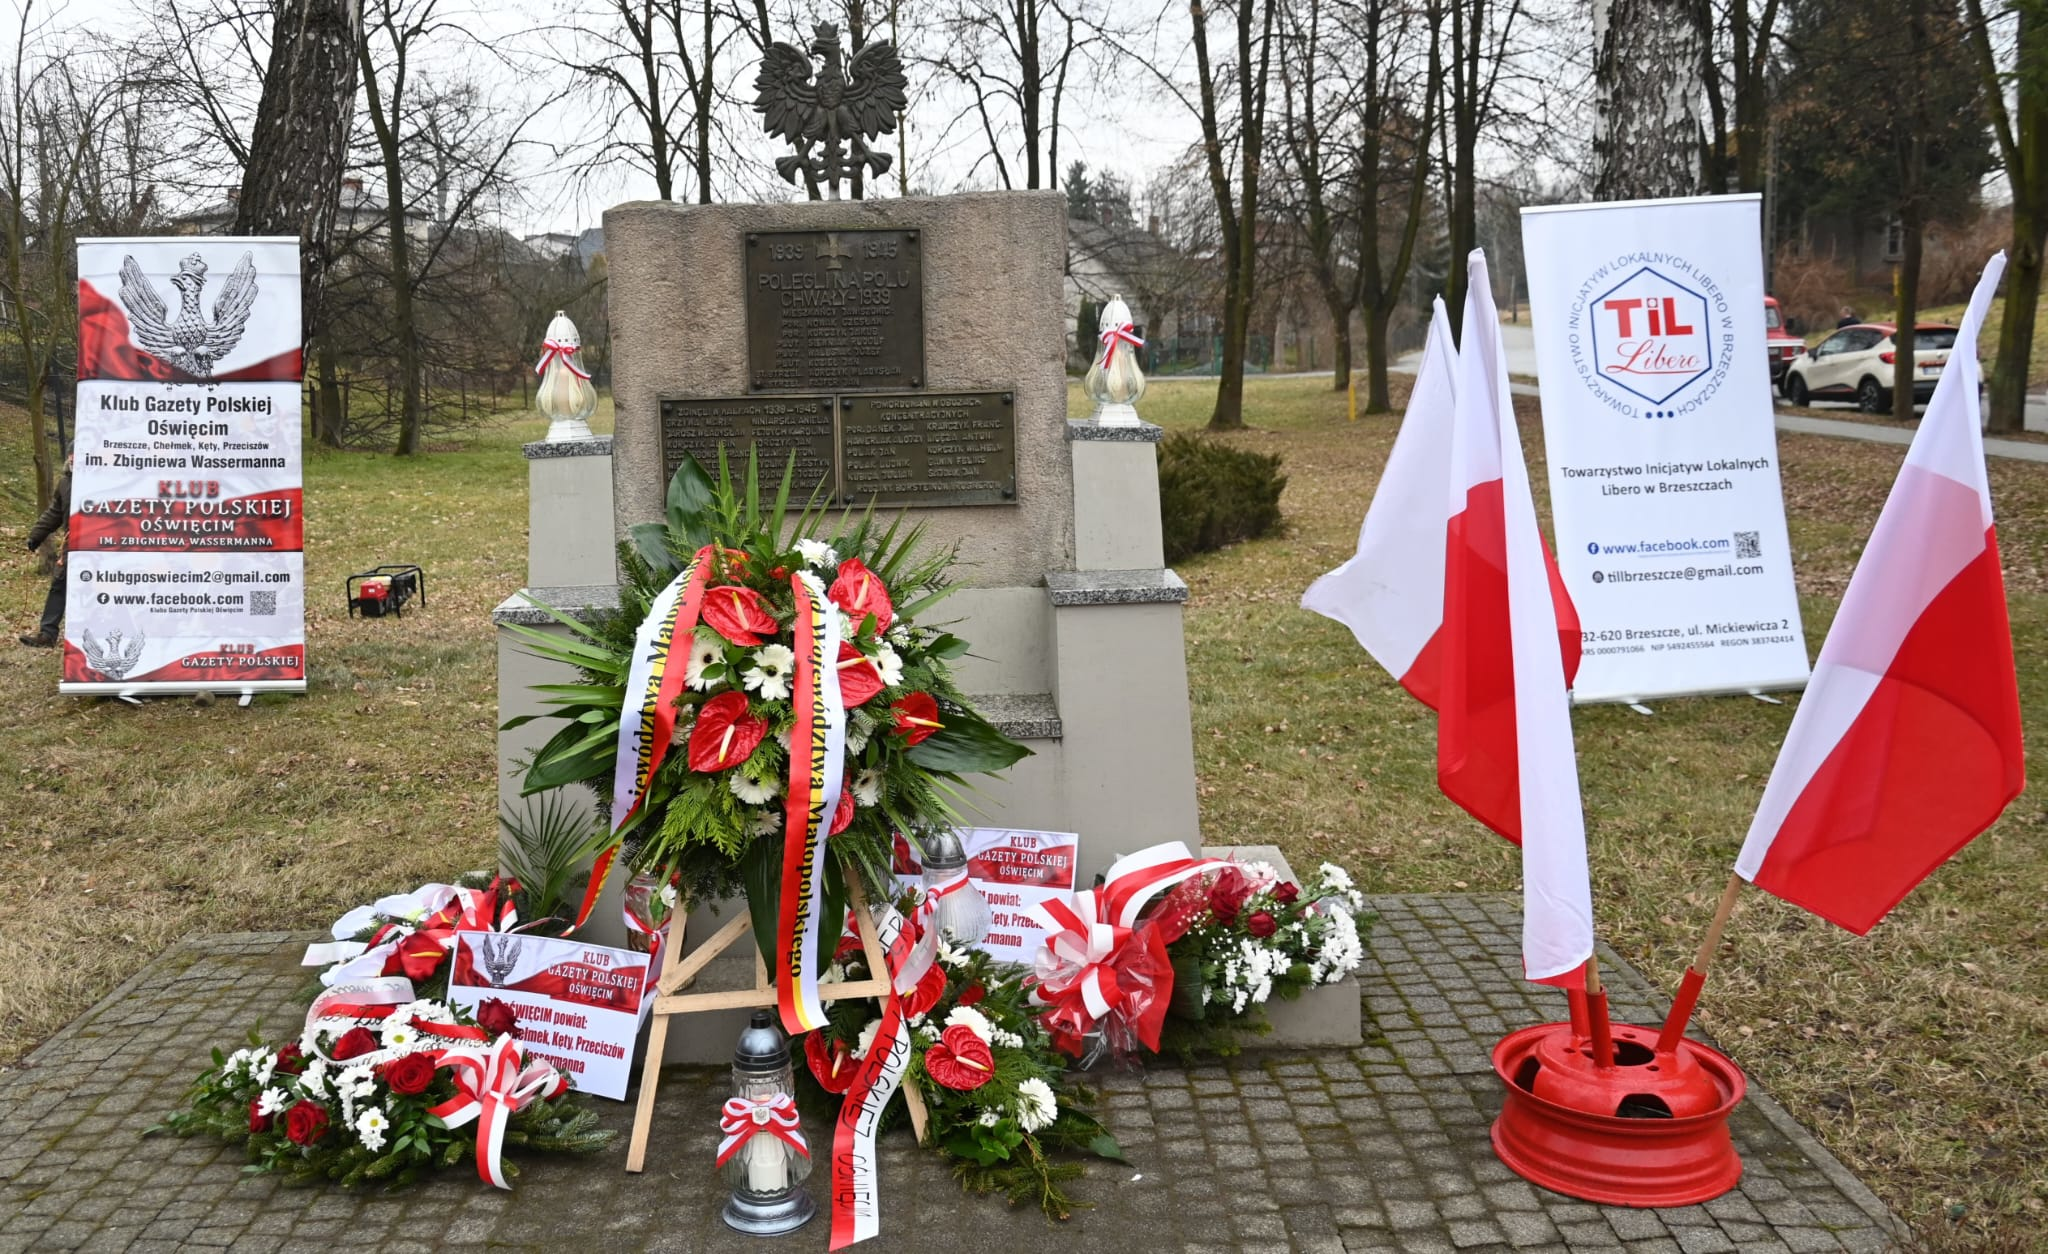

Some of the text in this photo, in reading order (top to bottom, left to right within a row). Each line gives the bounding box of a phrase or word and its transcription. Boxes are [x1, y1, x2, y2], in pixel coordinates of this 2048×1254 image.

[768, 239, 898, 261] 1939 1945
[758, 270, 910, 290] POLEGLI NA POLU
[1568, 251, 1734, 419] TOWARZYSTWO INICJATYW LOKALNYCH LIBERO W BRZESZCZACH
[1606, 339, 1702, 375] Libero
[101, 394, 272, 416] Klub Gazety Polskiej
[764, 404, 786, 415] 1939
[148, 420, 228, 439] Oświęcim
[103, 440, 269, 452] Brzeszcze, Chełmek, Kęty, Przeciszów
[85, 454, 286, 472] im. Zbigniewa Wassermanna
[1561, 457, 1769, 479] Towarzystwo Inicjatyw Lokalnych
[158, 480, 221, 498] KLUB
[1602, 479, 1733, 496] Libero w Brzeszczach
[80, 499, 292, 517] GAZETY POLSKIEJ
[140, 516, 235, 534] OŚWIĘCIM
[99, 537, 273, 546] IM. ZBIGNIEWA WASSERMANNA
[1603, 538, 1730, 555] www.facebook.com
[96, 571, 290, 585] klubgposwiecim2@gmail.com
[1608, 564, 1764, 584] tillbrzeszcze@gmail.com
[114, 593, 244, 605] www.facebook.com
[1582, 619, 1789, 642] 32-620 Brzeszcze, ul. Mickiewicza 2
[219, 644, 255, 654] KLUB
[1720, 638, 1749, 647] REGON
[182, 656, 299, 667] GAZETY POLSKIEJ
[805, 621, 832, 790] Województwa
[1010, 836, 1037, 848] KLUB
[978, 850, 1067, 868] GAZETY POLSKIEJ
[999, 865, 1044, 878] OŚWIĘCIM
[785, 799, 830, 978] Małopolskiego
[988, 892, 1021, 907] powiat:
[583, 951, 610, 966] KLUB
[547, 965, 638, 992] GAZETY POLSKIEJ
[569, 983, 614, 1000] OŚWIĘCIM
[505, 1001, 588, 1029] ŚWIĘCIM powiat:
[576, 1035, 625, 1060] Przeciszów
[842, 1033, 909, 1138] POLSKIEJ
